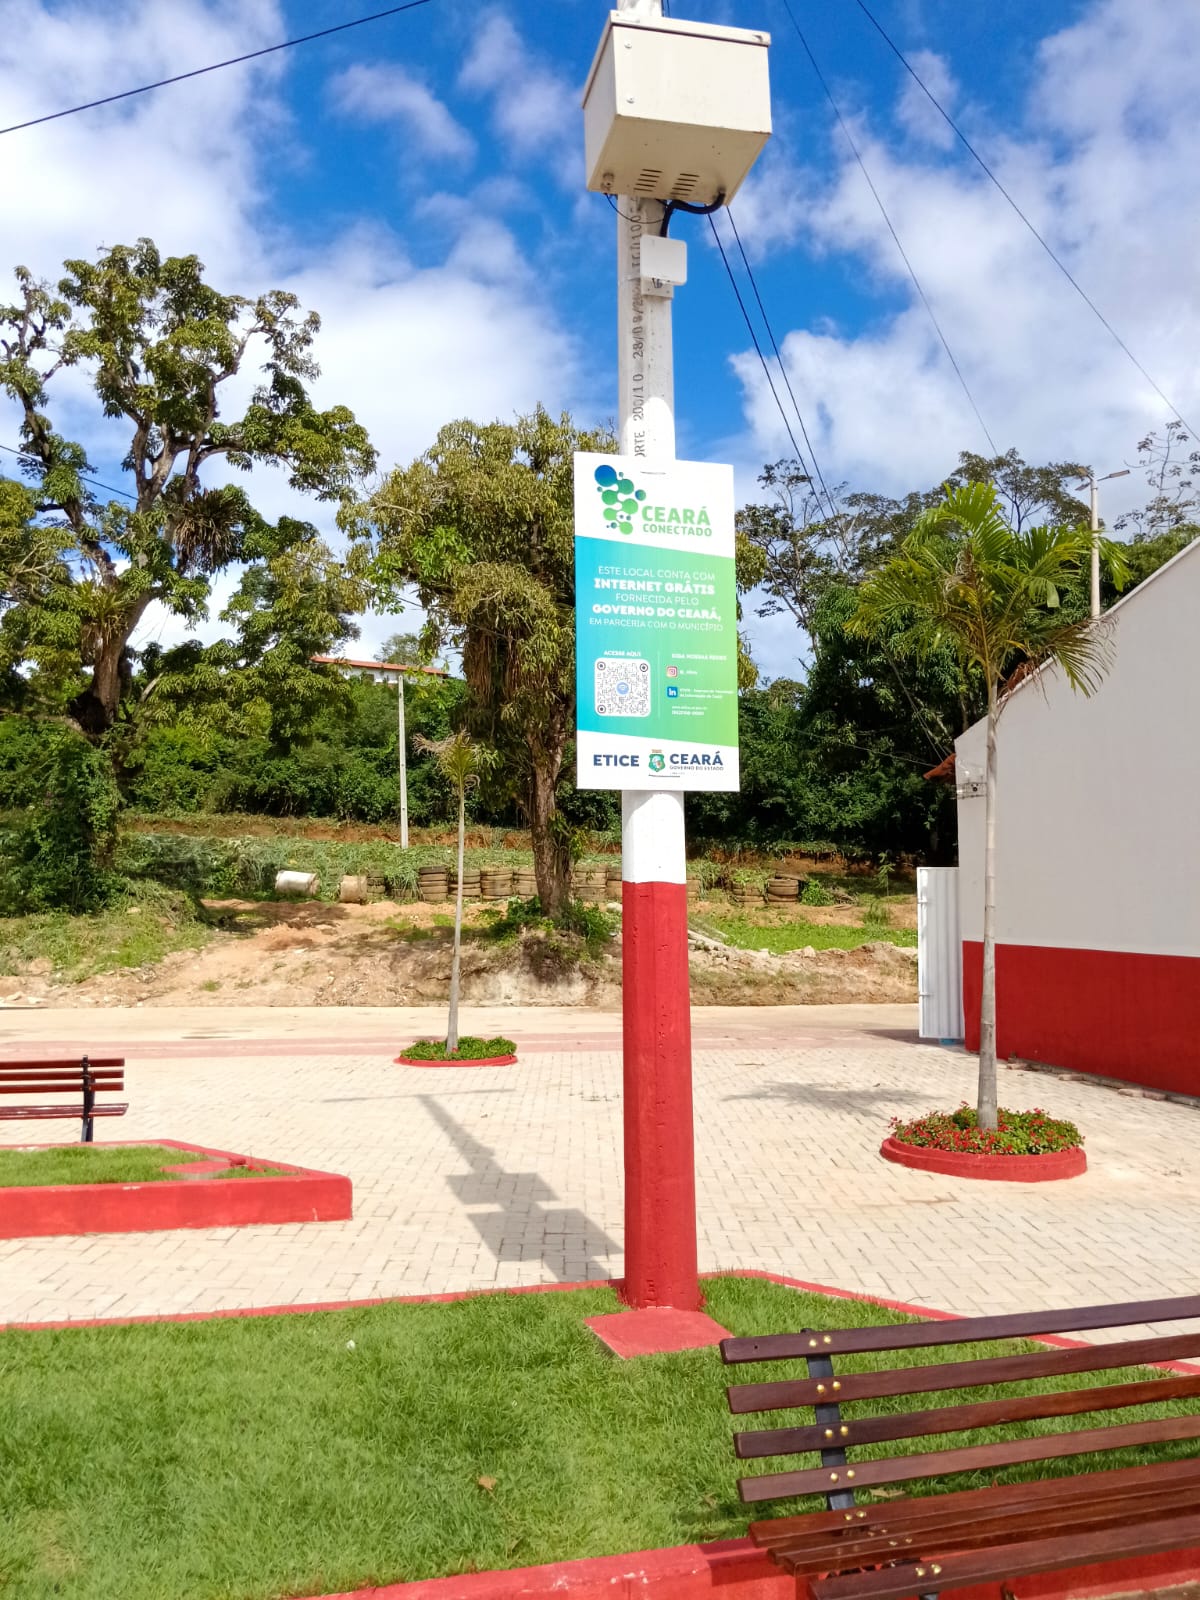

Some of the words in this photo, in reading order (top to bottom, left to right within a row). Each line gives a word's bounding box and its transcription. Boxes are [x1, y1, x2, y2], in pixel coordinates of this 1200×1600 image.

[642, 505, 711, 526] CEARÁ
[643, 523, 713, 537] CONECTADO
[598, 565, 621, 576] ESTE
[623, 567, 655, 578] LOCAL
[657, 569, 691, 580] CONTA
[692, 571, 715, 581] COM
[594, 577, 663, 592] INTERNET
[664, 580, 715, 595] GRÁTIS
[615, 593, 672, 604] FORNECIDA
[674, 596, 699, 606] PELO
[592, 604, 655, 617] GOVERNO
[657, 608, 676, 618] DO
[677, 606, 721, 622] CEARÁ,
[589, 617, 602, 626] EM
[603, 618, 646, 629] PARCERIA
[647, 621, 668, 630] COM
[668, 621, 676, 630] O
[677, 621, 724, 632] MUNICÍPIO
[593, 754, 640, 767] ETICE
[669, 751, 724, 766] CEARÁ
